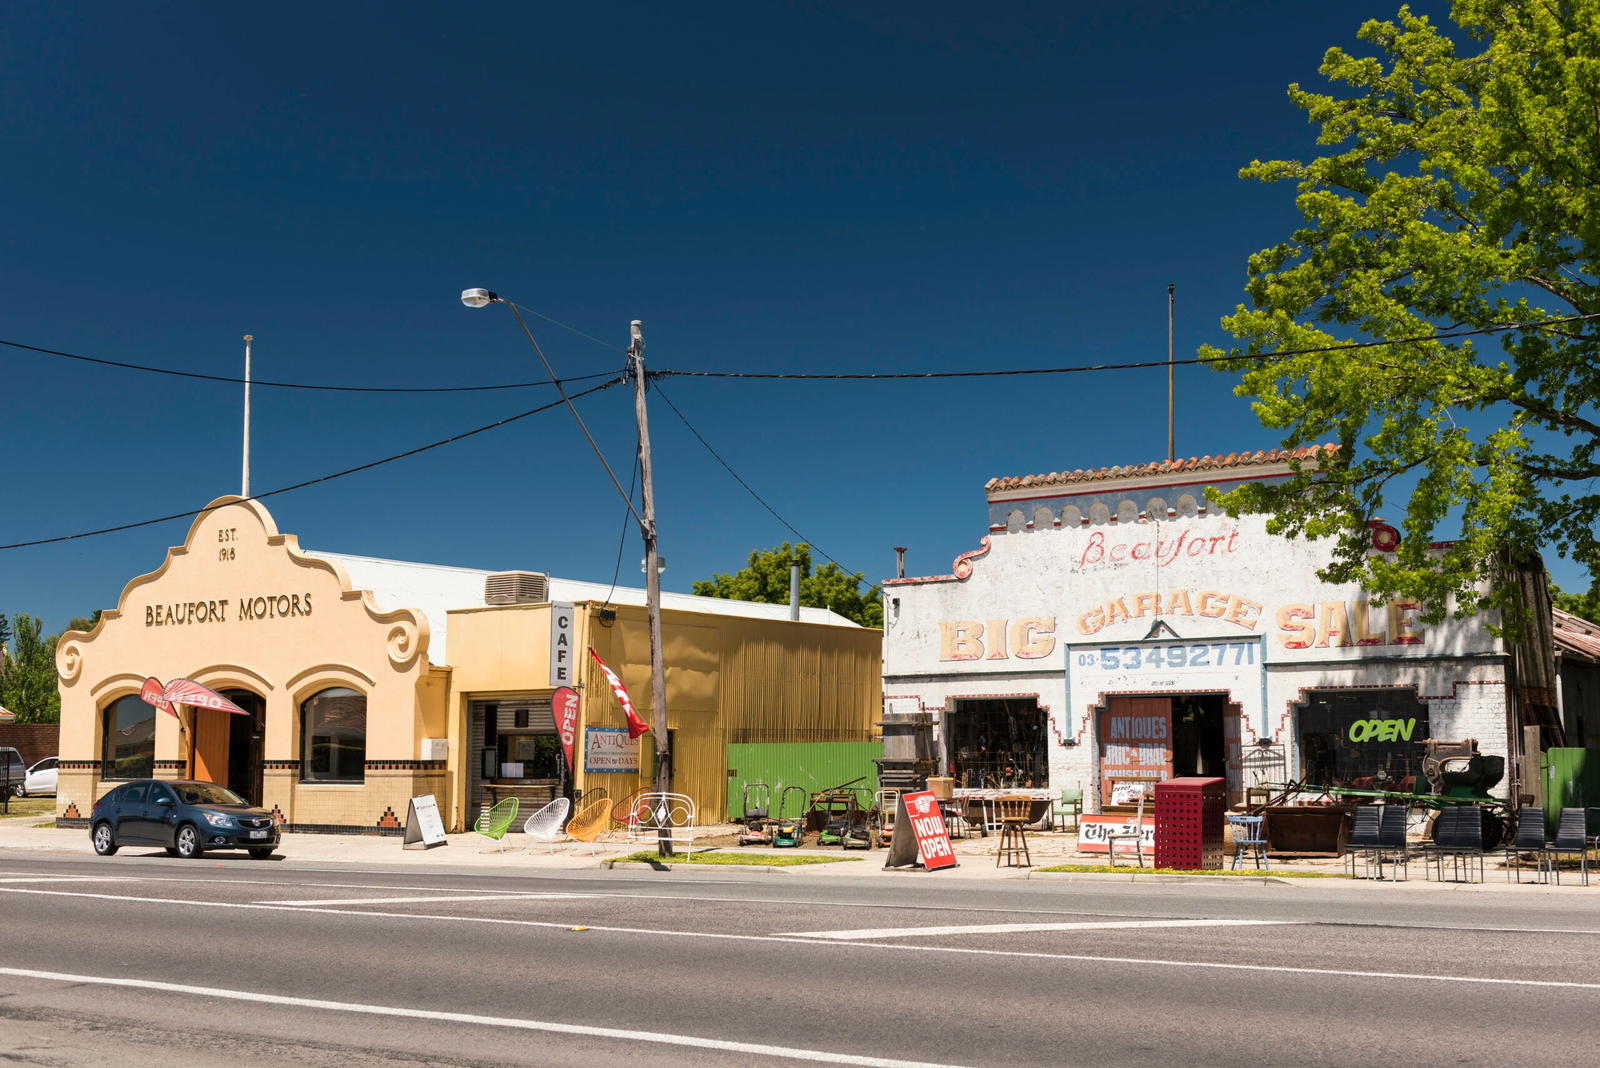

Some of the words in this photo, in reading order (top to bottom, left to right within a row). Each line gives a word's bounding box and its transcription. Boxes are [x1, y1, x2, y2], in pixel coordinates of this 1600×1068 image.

[218, 528, 238, 543] EST.
[218, 548, 236, 562] 1918
[1078, 528, 1239, 569] Beaufort
[145, 600, 229, 627] BEAUFORT
[238, 593, 313, 622] MOTORS
[938, 616, 1057, 662] BIG
[1077, 589, 1262, 636] GARAGE
[1276, 598, 1426, 649] SALE
[557, 615, 569, 680] CAFE
[1100, 642, 1254, 670] 53492771
[561, 694, 579, 745] OPEN
[1110, 717, 1167, 739] ANTIQUES
[1349, 718, 1416, 743] OPEN
[590, 733, 639, 750] ANTIQUES
[589, 757, 612, 765] OPEN
[618, 757, 638, 765] DAYS
[914, 816, 944, 837] NOW
[921, 836, 952, 860] OPEN
